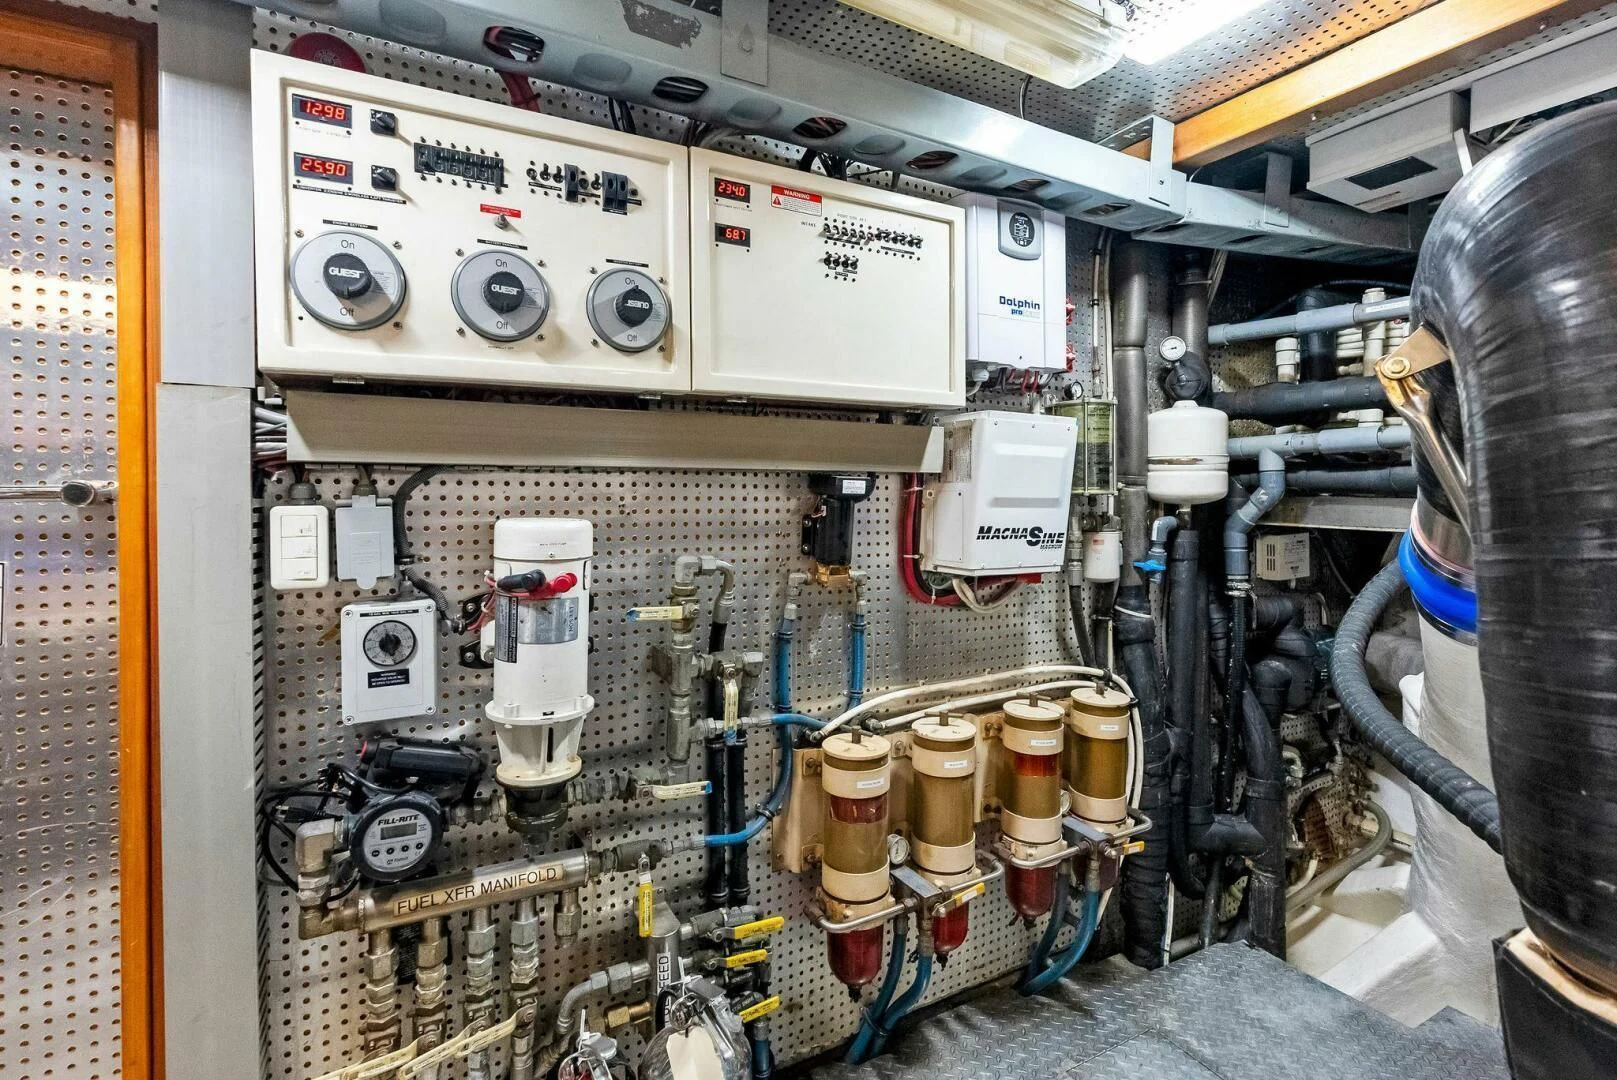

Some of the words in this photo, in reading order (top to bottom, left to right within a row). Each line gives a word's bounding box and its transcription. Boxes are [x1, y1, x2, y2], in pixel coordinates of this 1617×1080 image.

[304, 102, 346, 120] 12.98
[301, 158, 347, 176] 25.90
[784, 189, 811, 200] WARNING
[340, 239, 355, 249] On
[495, 258, 508, 268] On
[329, 267, 365, 278] GUEST
[624, 277, 636, 286] On
[491, 284, 521, 295] GUEST
[999, 296, 1041, 310] Dolphin
[340, 307, 355, 317] Off
[496, 321, 509, 330] Off
[627, 334, 638, 342] Off
[378, 813, 421, 826] FILL-RITE
[397, 895, 440, 914] FUEL
[444, 885, 476, 904] XFR
[480, 867, 558, 895] MANIFOLD
